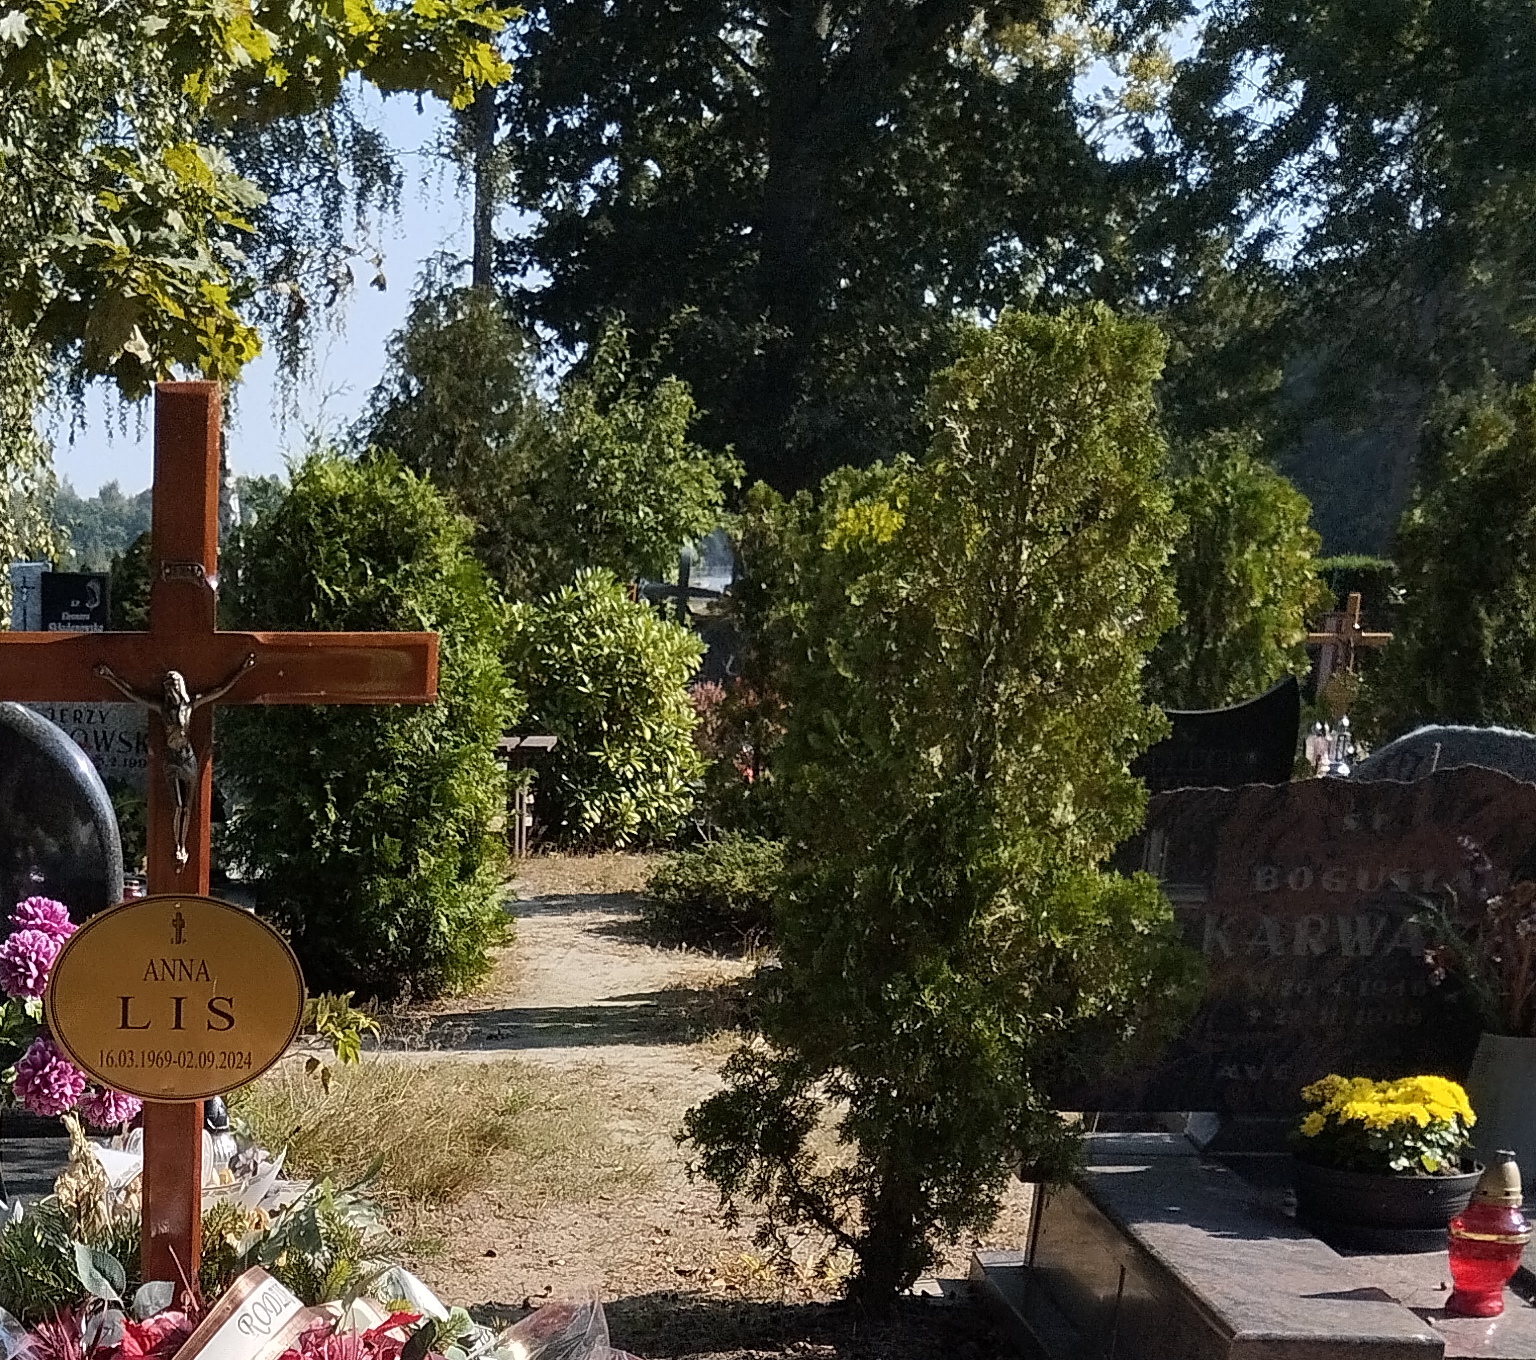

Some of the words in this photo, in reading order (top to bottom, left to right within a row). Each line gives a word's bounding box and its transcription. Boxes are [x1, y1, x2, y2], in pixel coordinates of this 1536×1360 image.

[1202, 912, 1424, 957] KARWA
[143, 958, 212, 982] ANNA
[98, 1050, 254, 1070] 16.03.1969-02.09.2024
